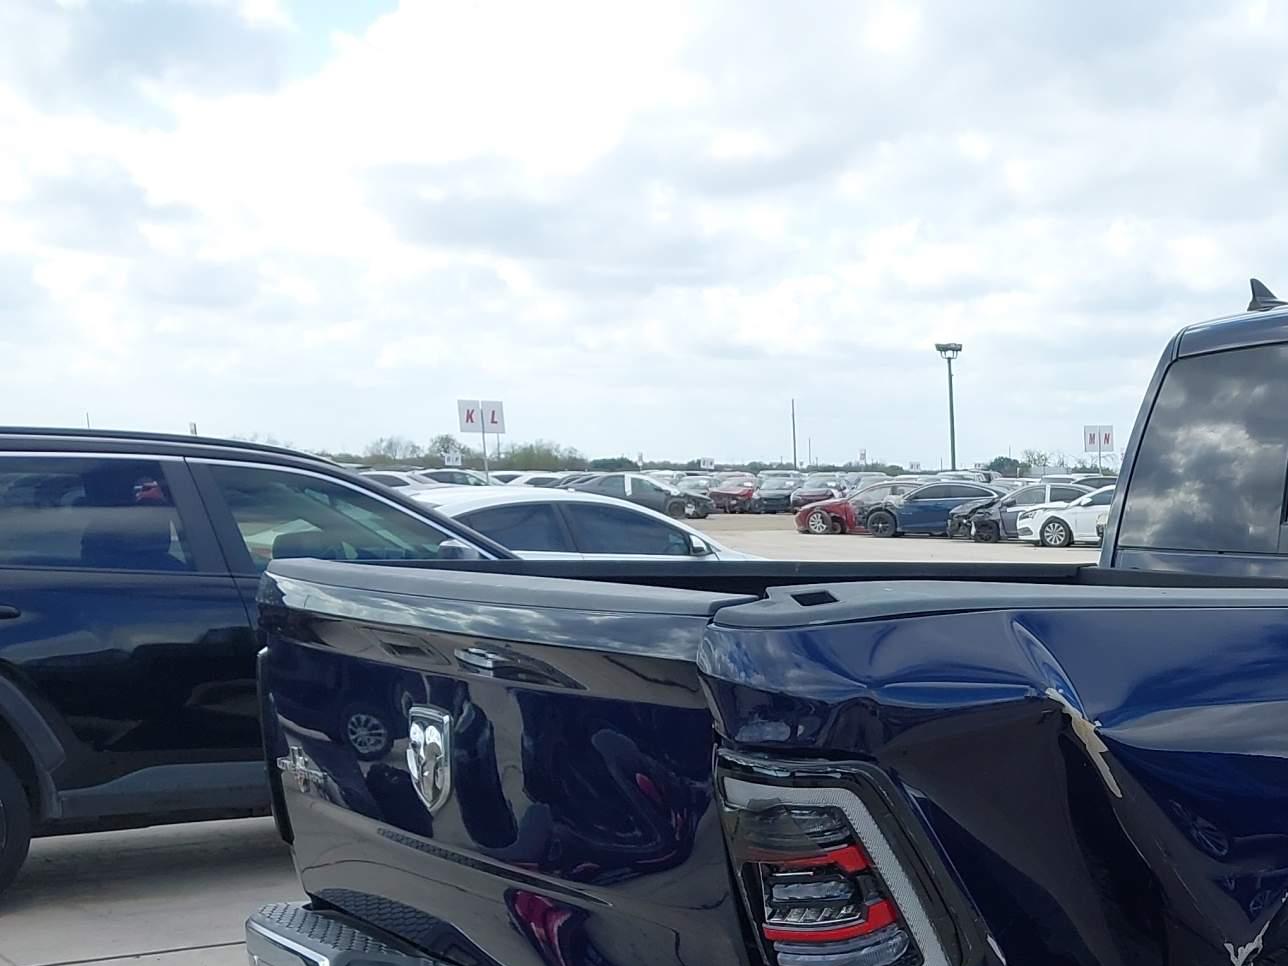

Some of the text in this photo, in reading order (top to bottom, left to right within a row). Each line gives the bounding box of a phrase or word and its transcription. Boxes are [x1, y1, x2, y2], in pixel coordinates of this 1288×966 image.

[465, 408, 475, 424] K
[490, 409, 498, 425] L
[1103, 432, 1111, 445] N
